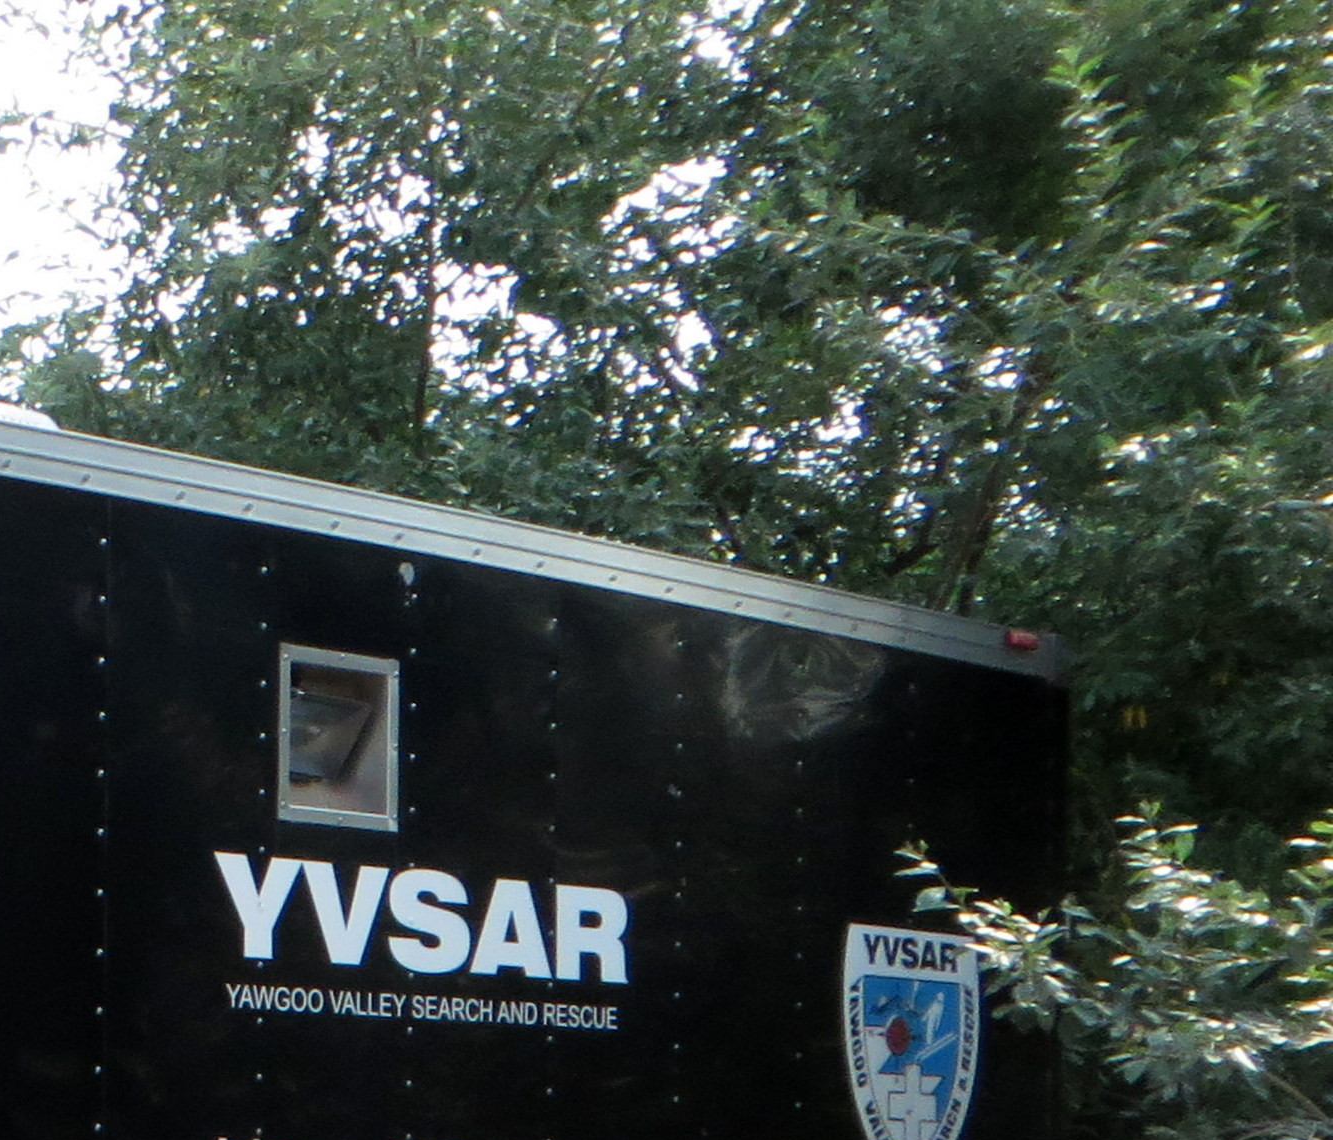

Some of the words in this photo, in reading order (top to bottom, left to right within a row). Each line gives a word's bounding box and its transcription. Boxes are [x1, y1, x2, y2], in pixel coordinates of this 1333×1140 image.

[213, 850, 630, 984] YVSAR
[862, 933, 959, 973] YVSAR
[225, 983, 324, 1014] YAWGOO
[329, 989, 407, 1018] VALLEY
[411, 994, 494, 1023] SEARCH
[498, 999, 538, 1026] AND
[542, 1003, 620, 1031] RESCUE
